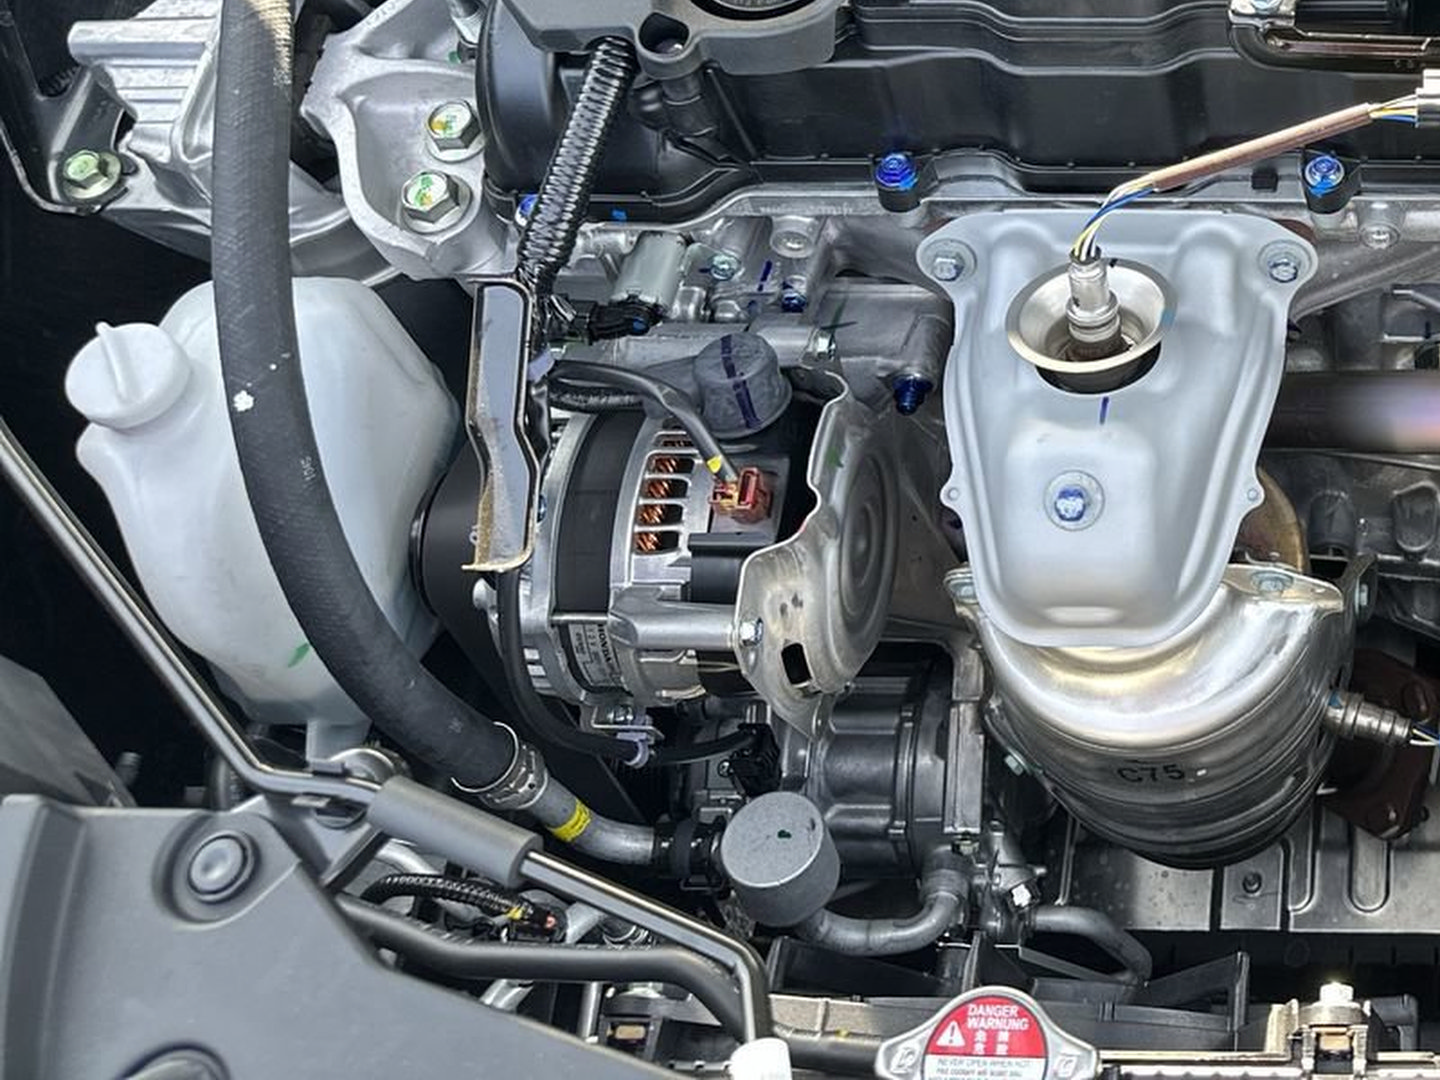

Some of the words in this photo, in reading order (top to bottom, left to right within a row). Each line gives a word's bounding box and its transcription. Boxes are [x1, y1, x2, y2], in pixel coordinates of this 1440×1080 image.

[597, 623, 612, 662] HONDA
[967, 1004, 1019, 1018] DANGER
[966, 1016, 1030, 1031] WARNUNG
